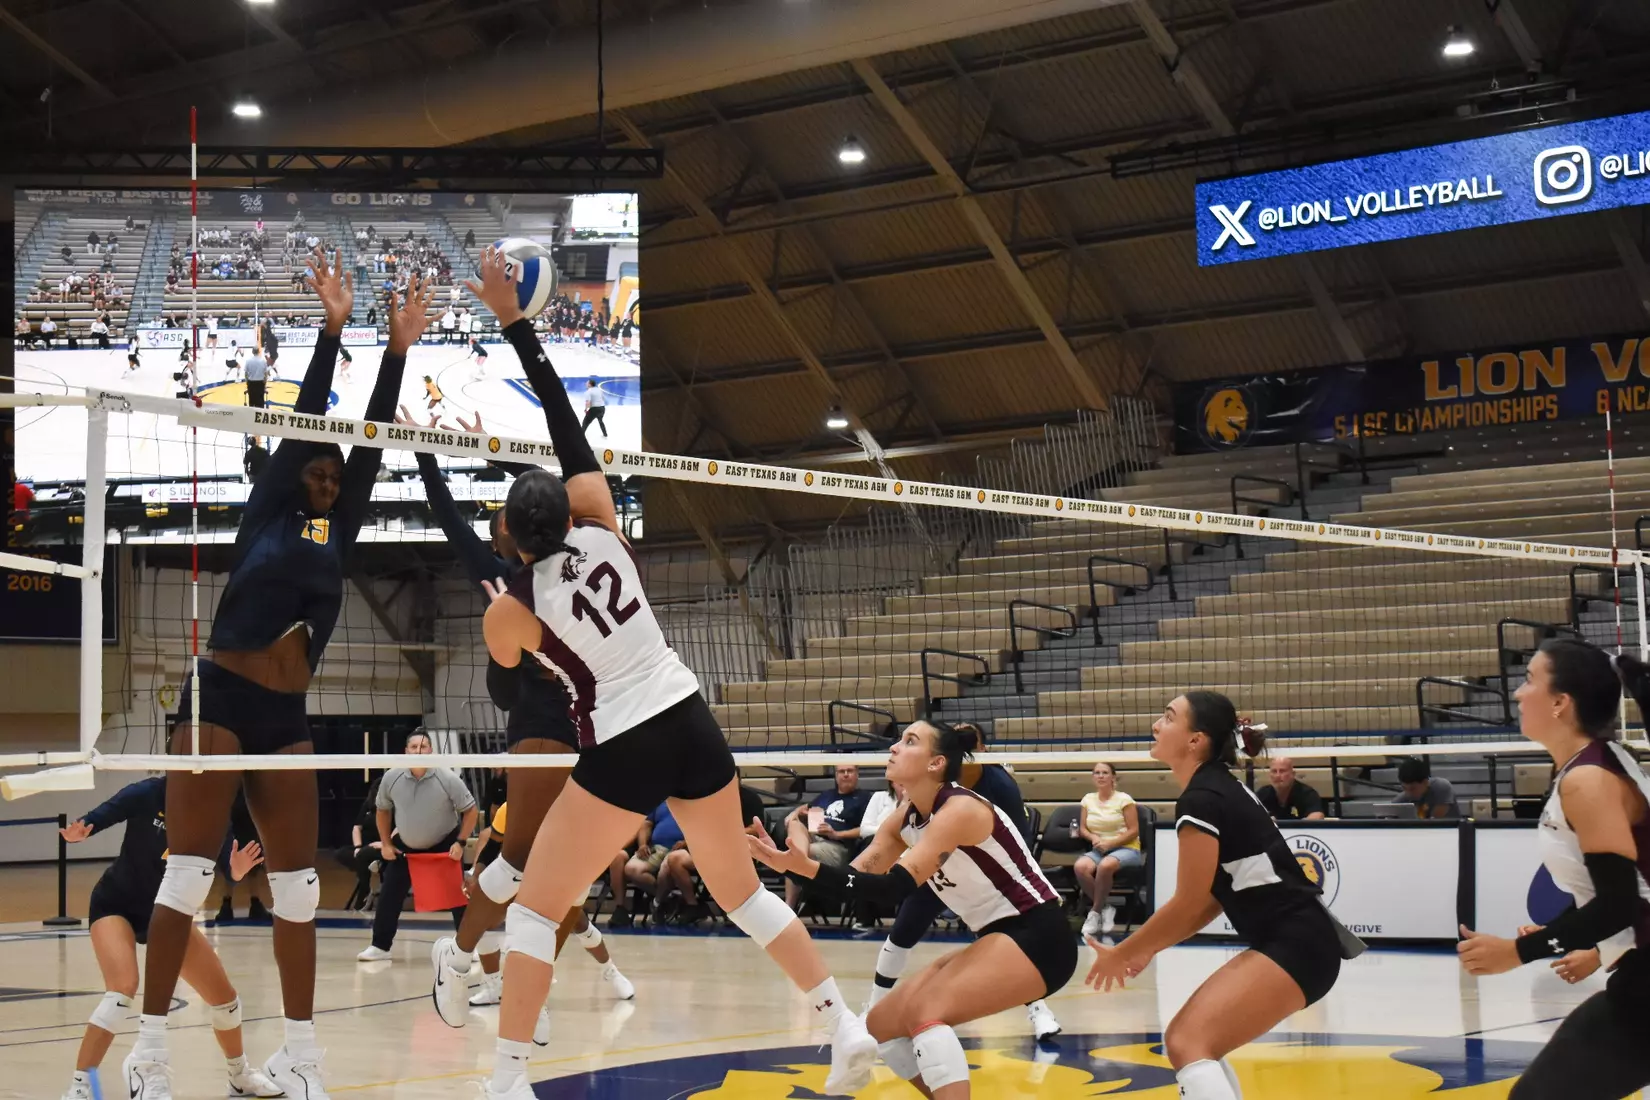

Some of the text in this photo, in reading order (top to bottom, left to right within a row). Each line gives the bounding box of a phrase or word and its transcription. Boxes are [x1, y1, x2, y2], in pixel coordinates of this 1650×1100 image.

[331, 193, 361, 205] GO
[1258, 175, 1502, 230] @LION_VOLLEYBALL
[1421, 346, 1566, 400] LION
[1617, 385, 1650, 413] NC
[254, 412, 354, 435] EAST TEXAS A&M
[387, 428, 480, 448] EAST TEXAS A&M
[510, 442, 536, 455] EAST
[622, 454, 700, 472] EAST TEXAS A&M
[725, 465, 797, 483] EAST TEXAS A&M
[821, 476, 887, 492] EAST TEXAS A&M
[909, 485, 972, 500] EAST TEXAS A&M
[991, 494, 1050, 508] EAST TEXAS A&M
[1068, 501, 1122, 515] EAST TEXAS A&M
[1140, 507, 1190, 521] EAST TEXAS A&M
[1207, 515, 1222, 524] EAST
[1223, 517, 1241, 527] TEXAS
[8, 575, 51, 592] 2016
[572, 560, 641, 639] 12
[1296, 839, 1335, 873] LIONS
